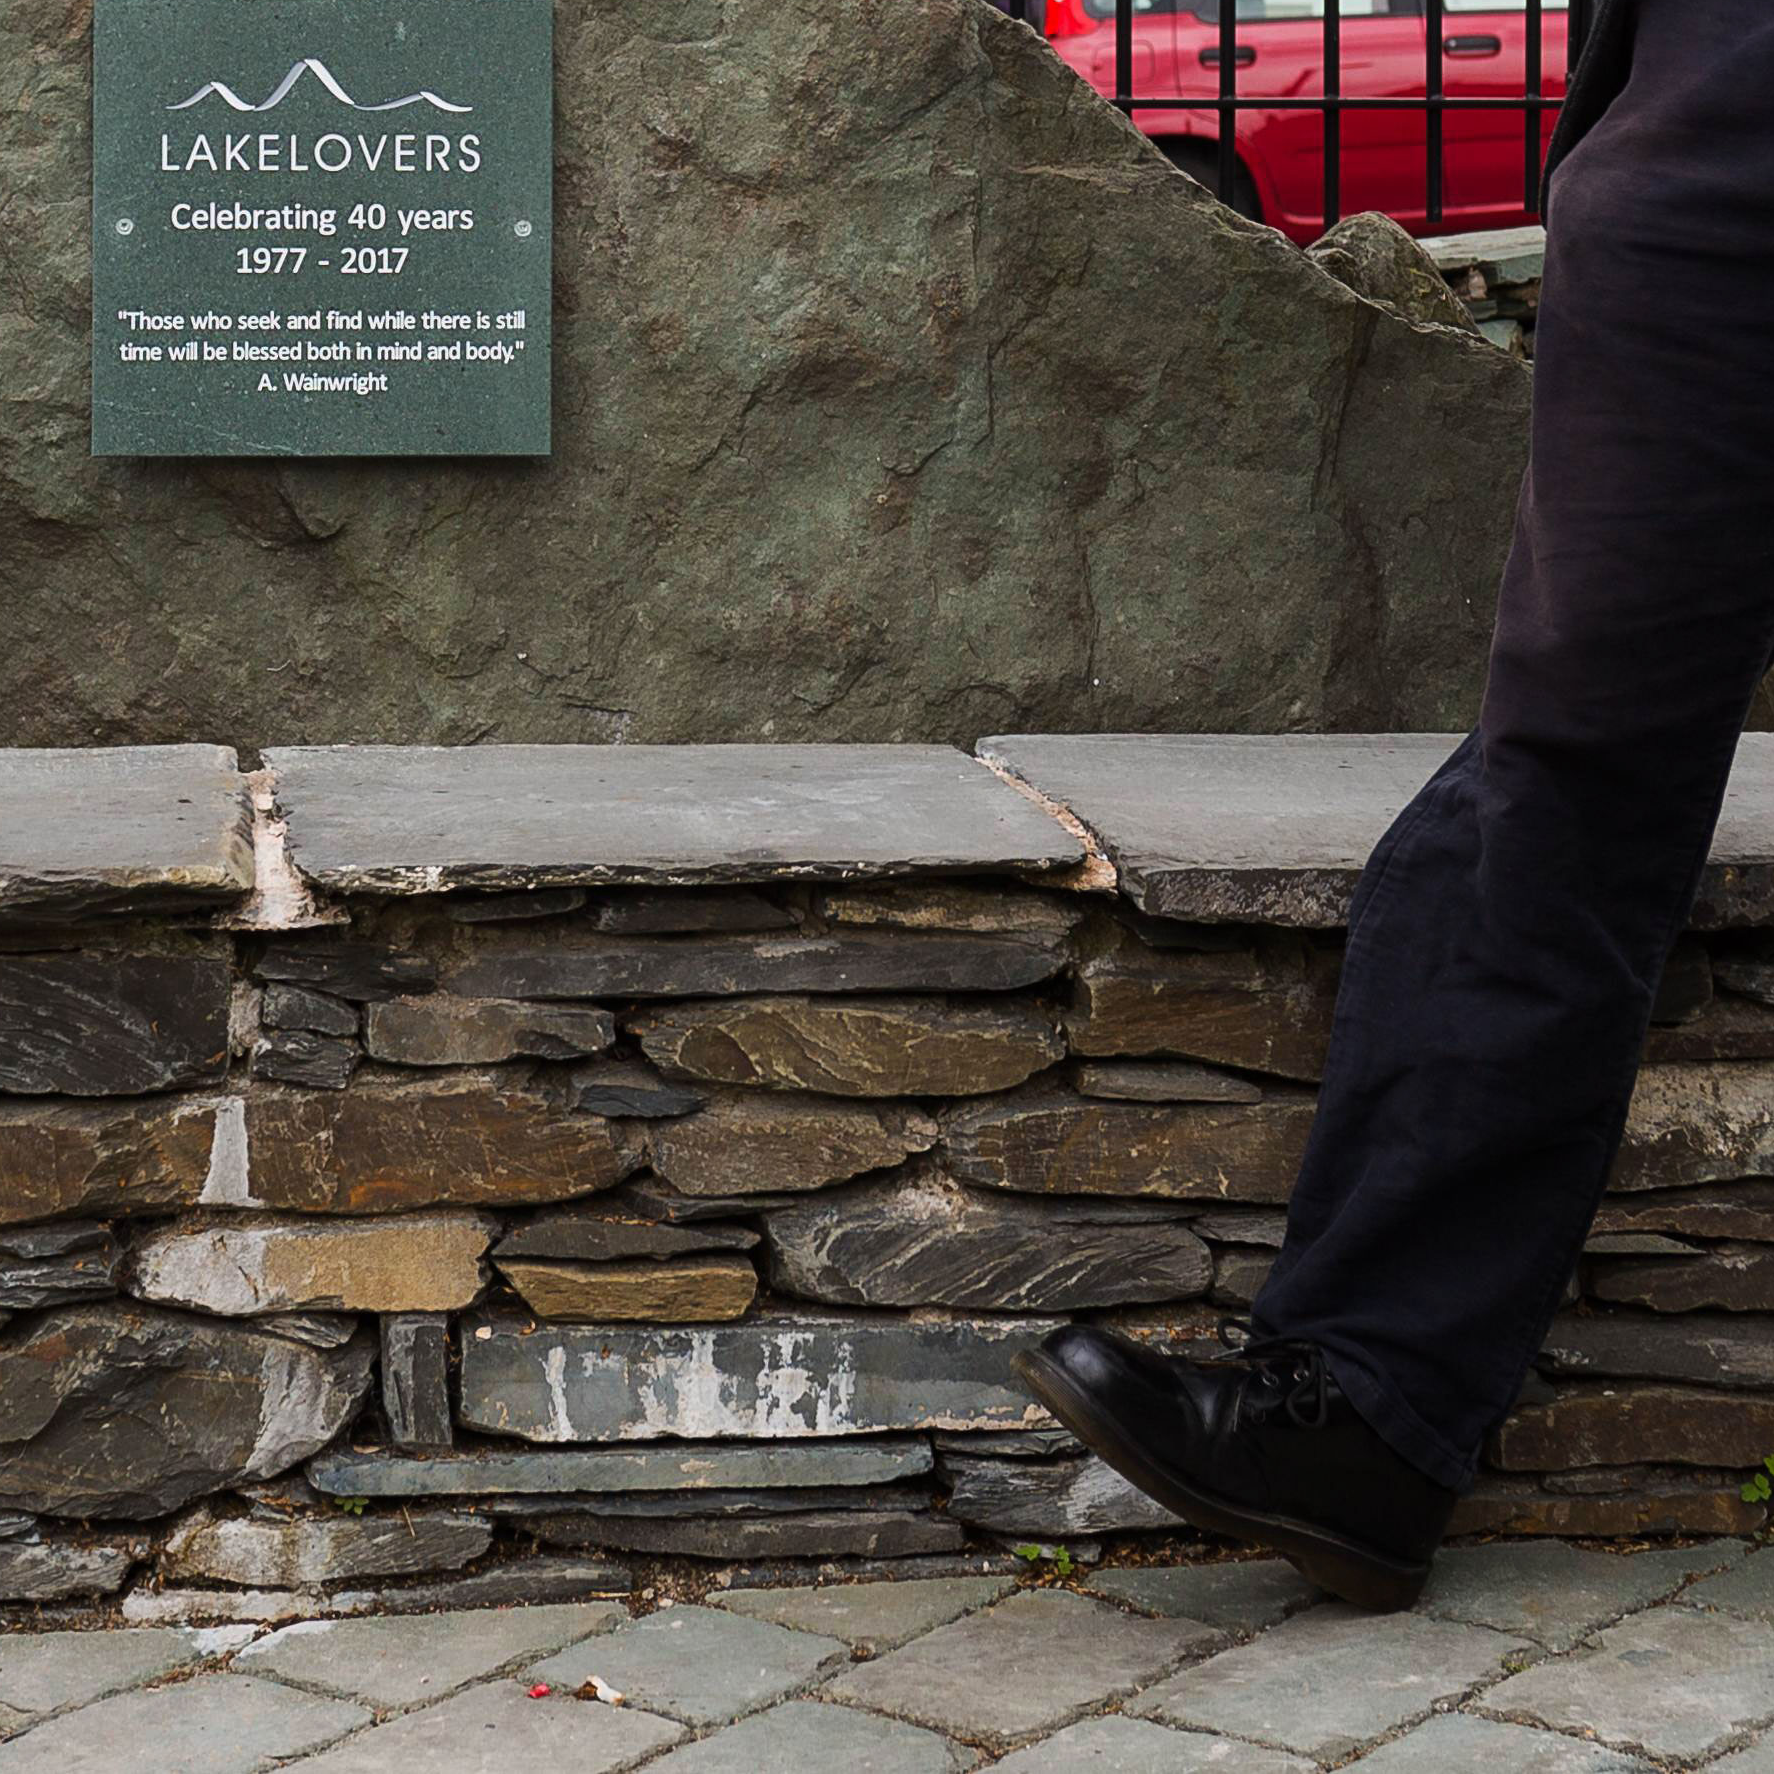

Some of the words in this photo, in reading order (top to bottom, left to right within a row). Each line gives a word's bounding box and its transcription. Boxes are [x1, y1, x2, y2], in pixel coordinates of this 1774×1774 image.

[161, 133, 481, 173] LAKELOVERS
[170, 202, 337, 235] Celebrating
[347, 202, 386, 230] 40
[397, 209, 474, 237] years
[236, 247, 307, 274] 1977
[340, 247, 409, 274] 2017
[117, 310, 185, 331] "Those
[190, 310, 233, 331] who
[237, 310, 282, 331] seek
[286, 310, 321, 331] and
[325, 310, 363, 331] find
[367, 310, 416, 331] while
[420, 310, 472, 331] there
[476, 310, 491, 331] is
[495, 310, 526, 330] still
[119, 341, 163, 362] time
[167, 341, 198, 362] will
[203, 341, 228, 362] be
[232, 341, 302, 362] blessed
[307, 341, 352, 362] both
[355, 341, 372, 362] in
[377, 341, 422, 362] mind
[426, 341, 461, 362] and
[465, 341, 526, 366] body."
[257, 373, 278, 392] A.
[283, 372, 389, 397] Wainwright
